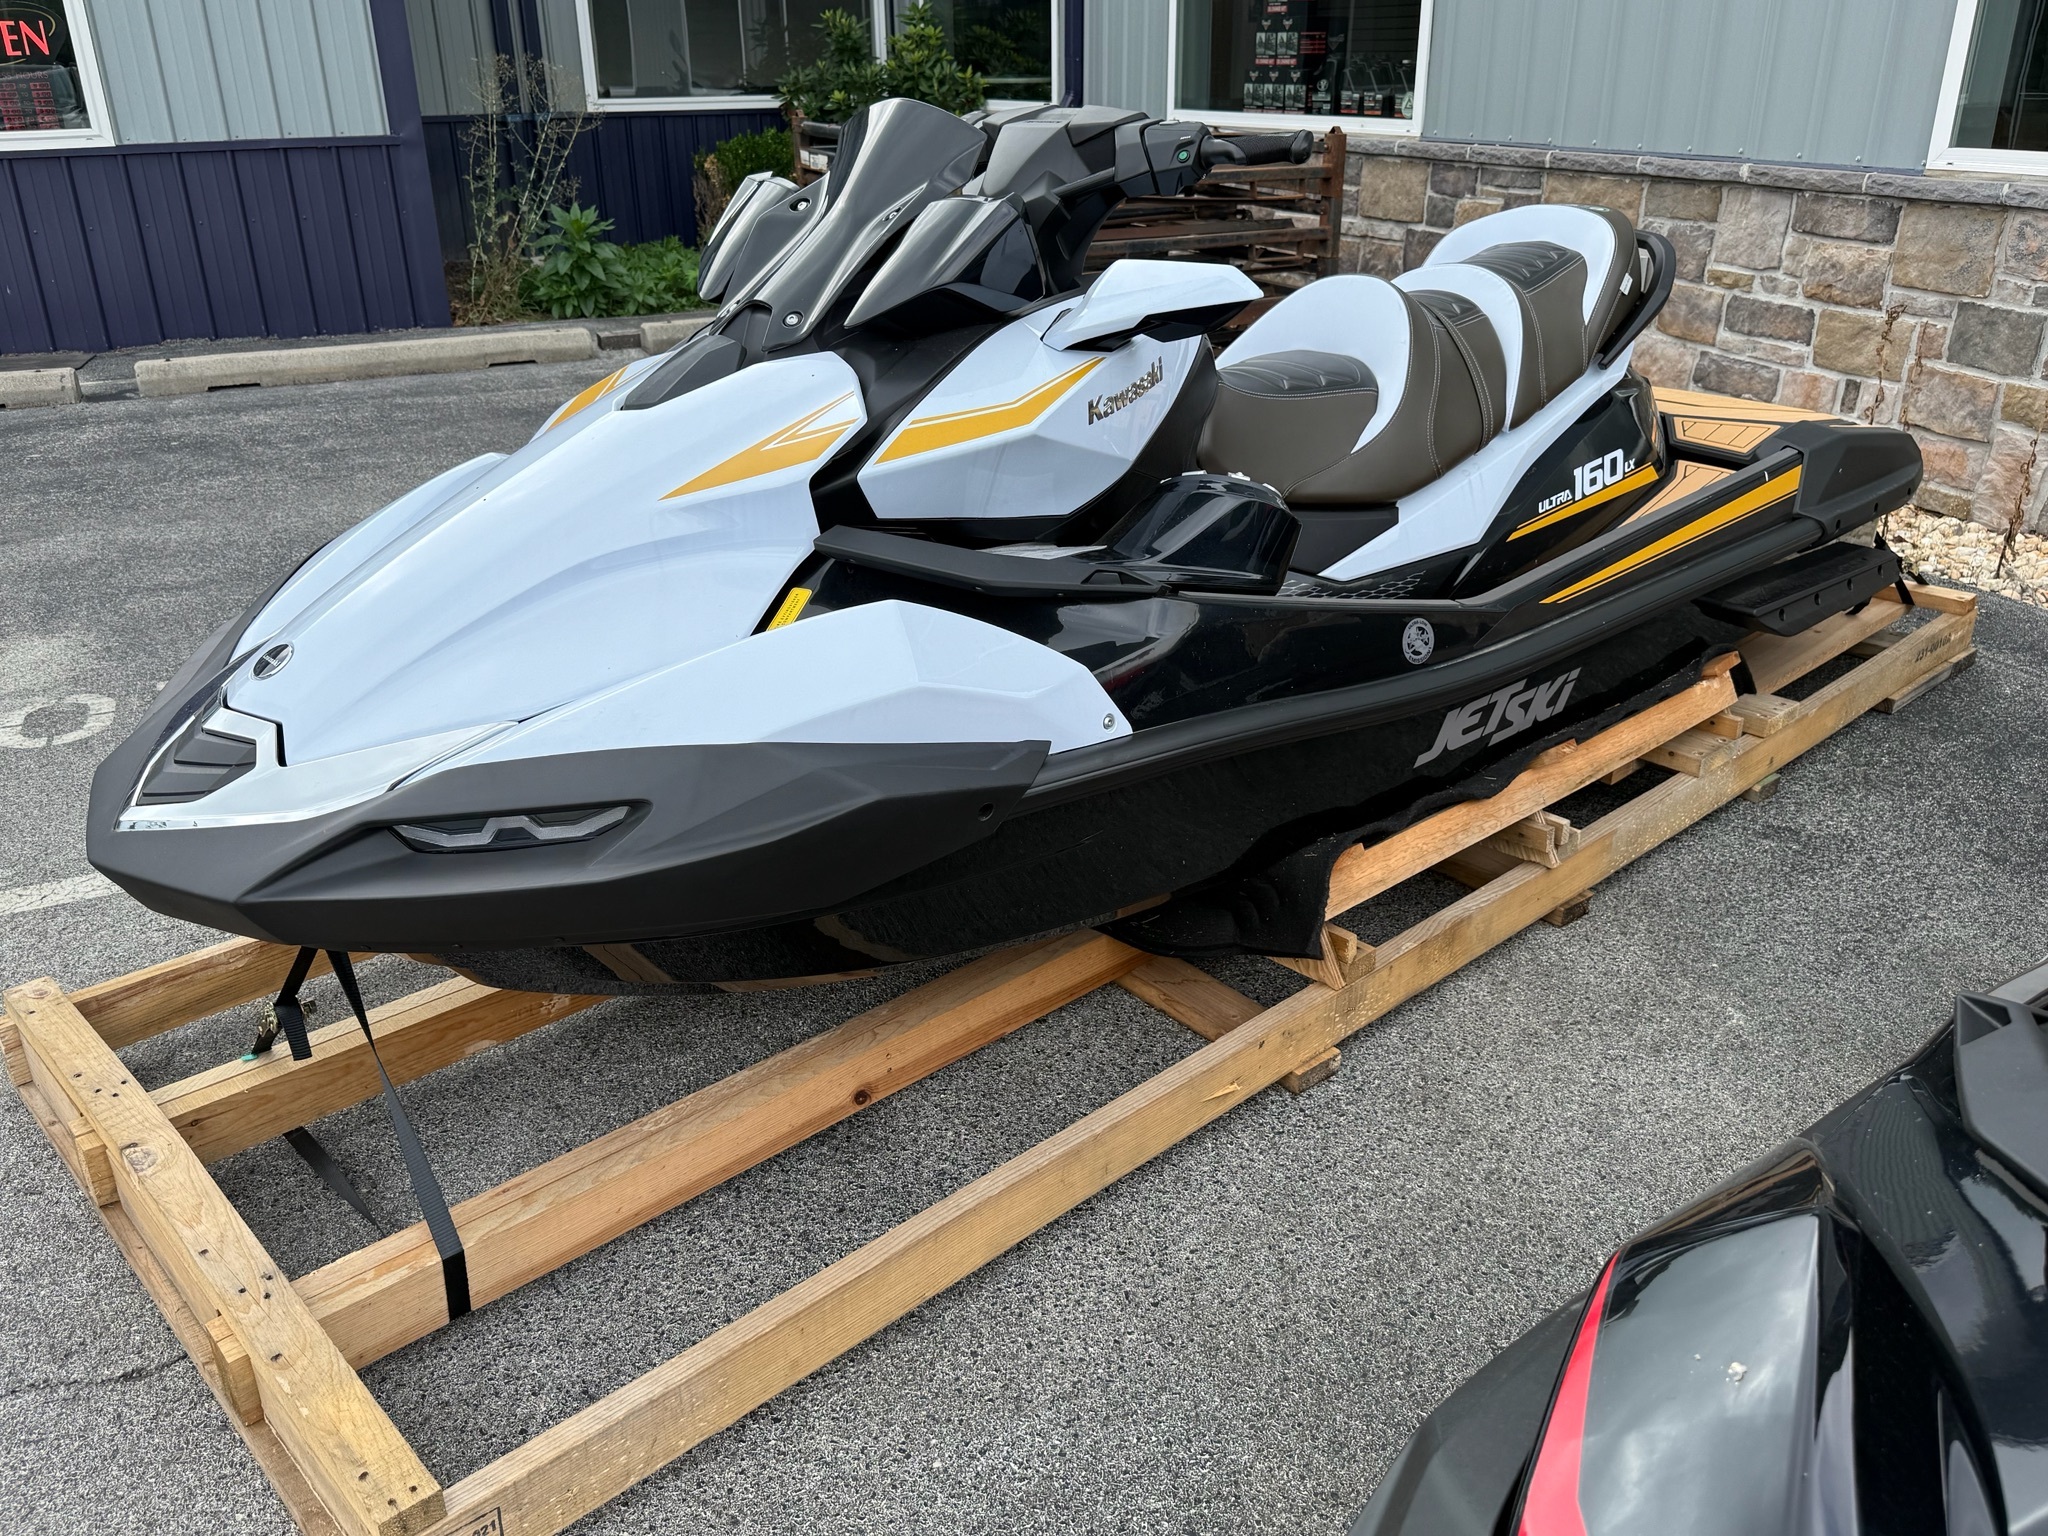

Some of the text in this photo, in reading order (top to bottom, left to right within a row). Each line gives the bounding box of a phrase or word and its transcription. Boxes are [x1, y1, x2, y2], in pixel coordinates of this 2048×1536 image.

[16, 71, 49, 79] HOURS
[1088, 356, 1163, 425] Kawasaki
[1538, 448, 1635, 513] ULTRA 160 LX
